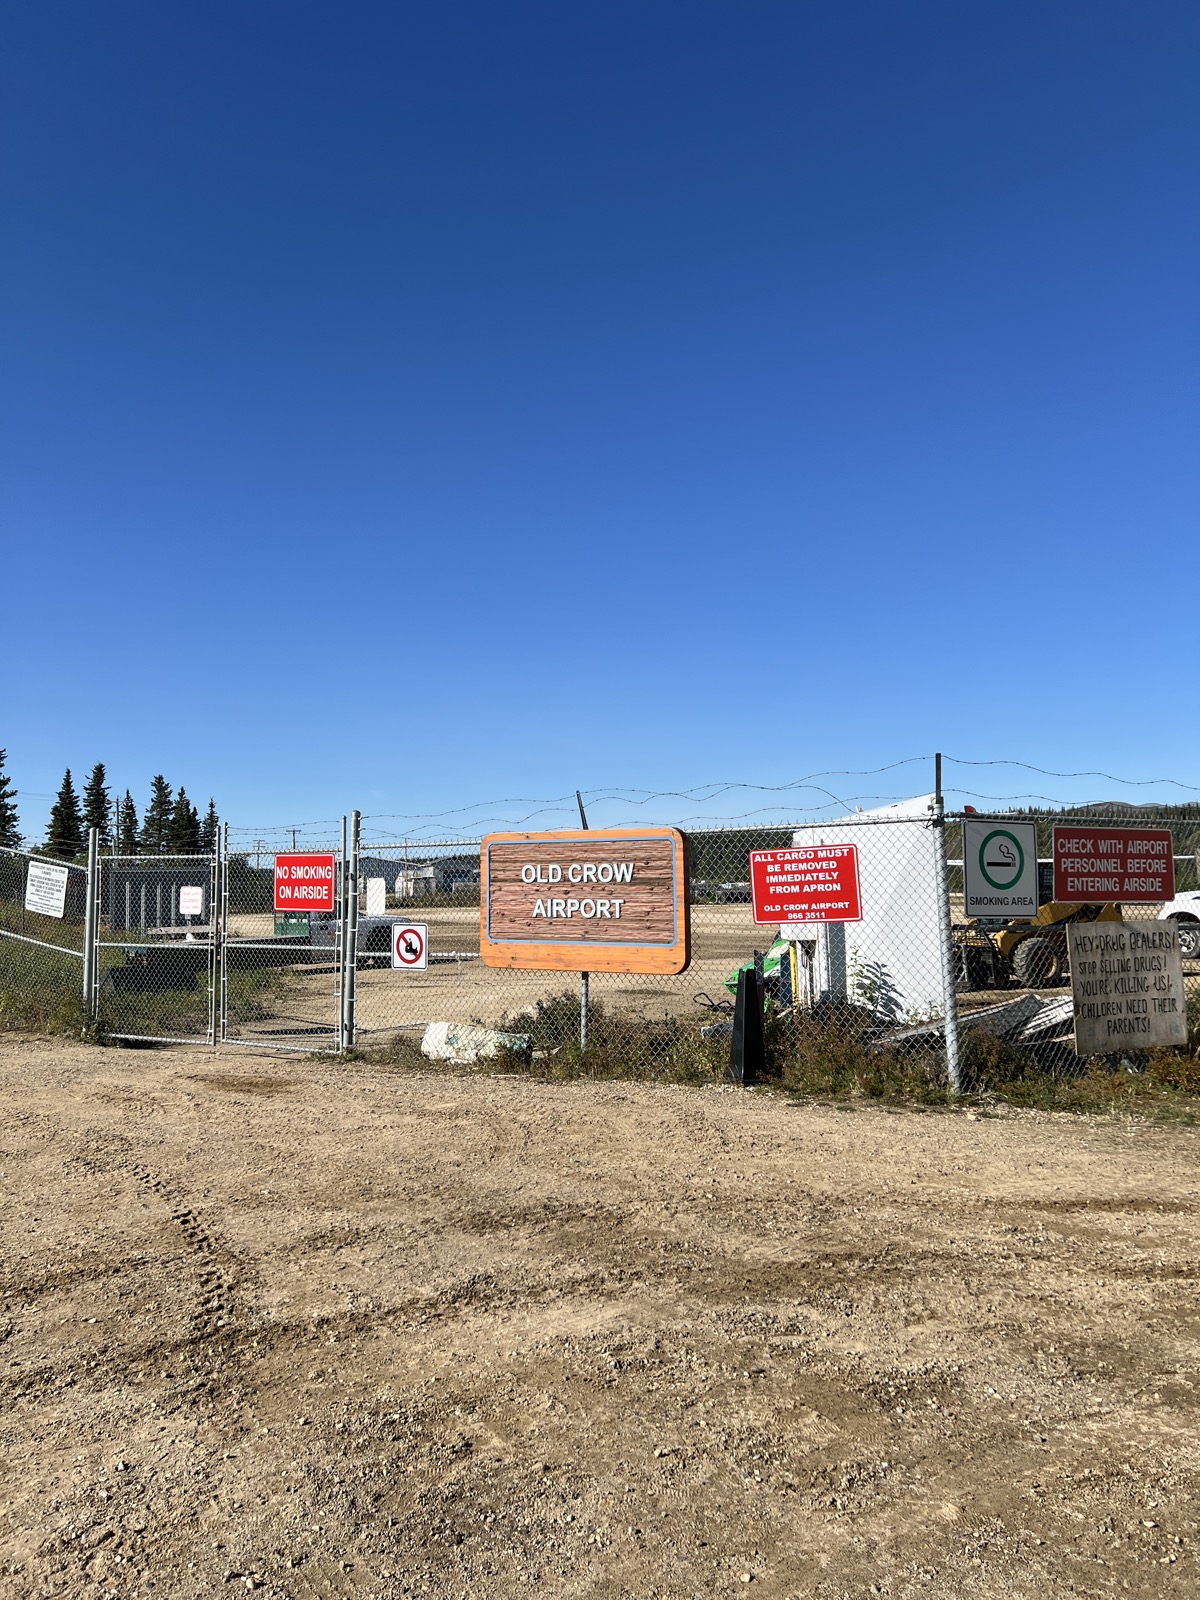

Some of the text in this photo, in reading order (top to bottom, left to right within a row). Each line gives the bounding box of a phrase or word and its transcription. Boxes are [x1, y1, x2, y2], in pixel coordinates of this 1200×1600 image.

[1058, 839, 1168, 855] CHECK WITH AIRPORT
[754, 848, 850, 862] ALL CARGO MUST
[767, 861, 838, 872] BE REMOVED
[1061, 858, 1167, 873] PERSONNEL BEFORE
[276, 866, 332, 880] NO SMOKING
[521, 862, 635, 884] OLD CROW
[766, 872, 839, 884] IMMEDIATELY
[770, 883, 841, 894] FROM APRON
[1068, 878, 1163, 892] ENTERING AIRSIDE
[279, 886, 329, 900] ON AIRSIDE
[810, 902, 850, 910] AIRPORT
[970, 896, 1034, 906] SMOKING AREA
[532, 898, 625, 919] AIRPORT
[787, 912, 826, 920] 966 3511
[1100, 934, 1126, 952] DRUG
[1130, 932, 1176, 950] DEALERS!
[1078, 955, 1167, 975] STOP SELLING DRUGS!
[1114, 976, 1150, 994] KILLING
[1081, 998, 1178, 1019] CHILDREN NEED THEIR
[1107, 1016, 1150, 1036] PARENTS!
